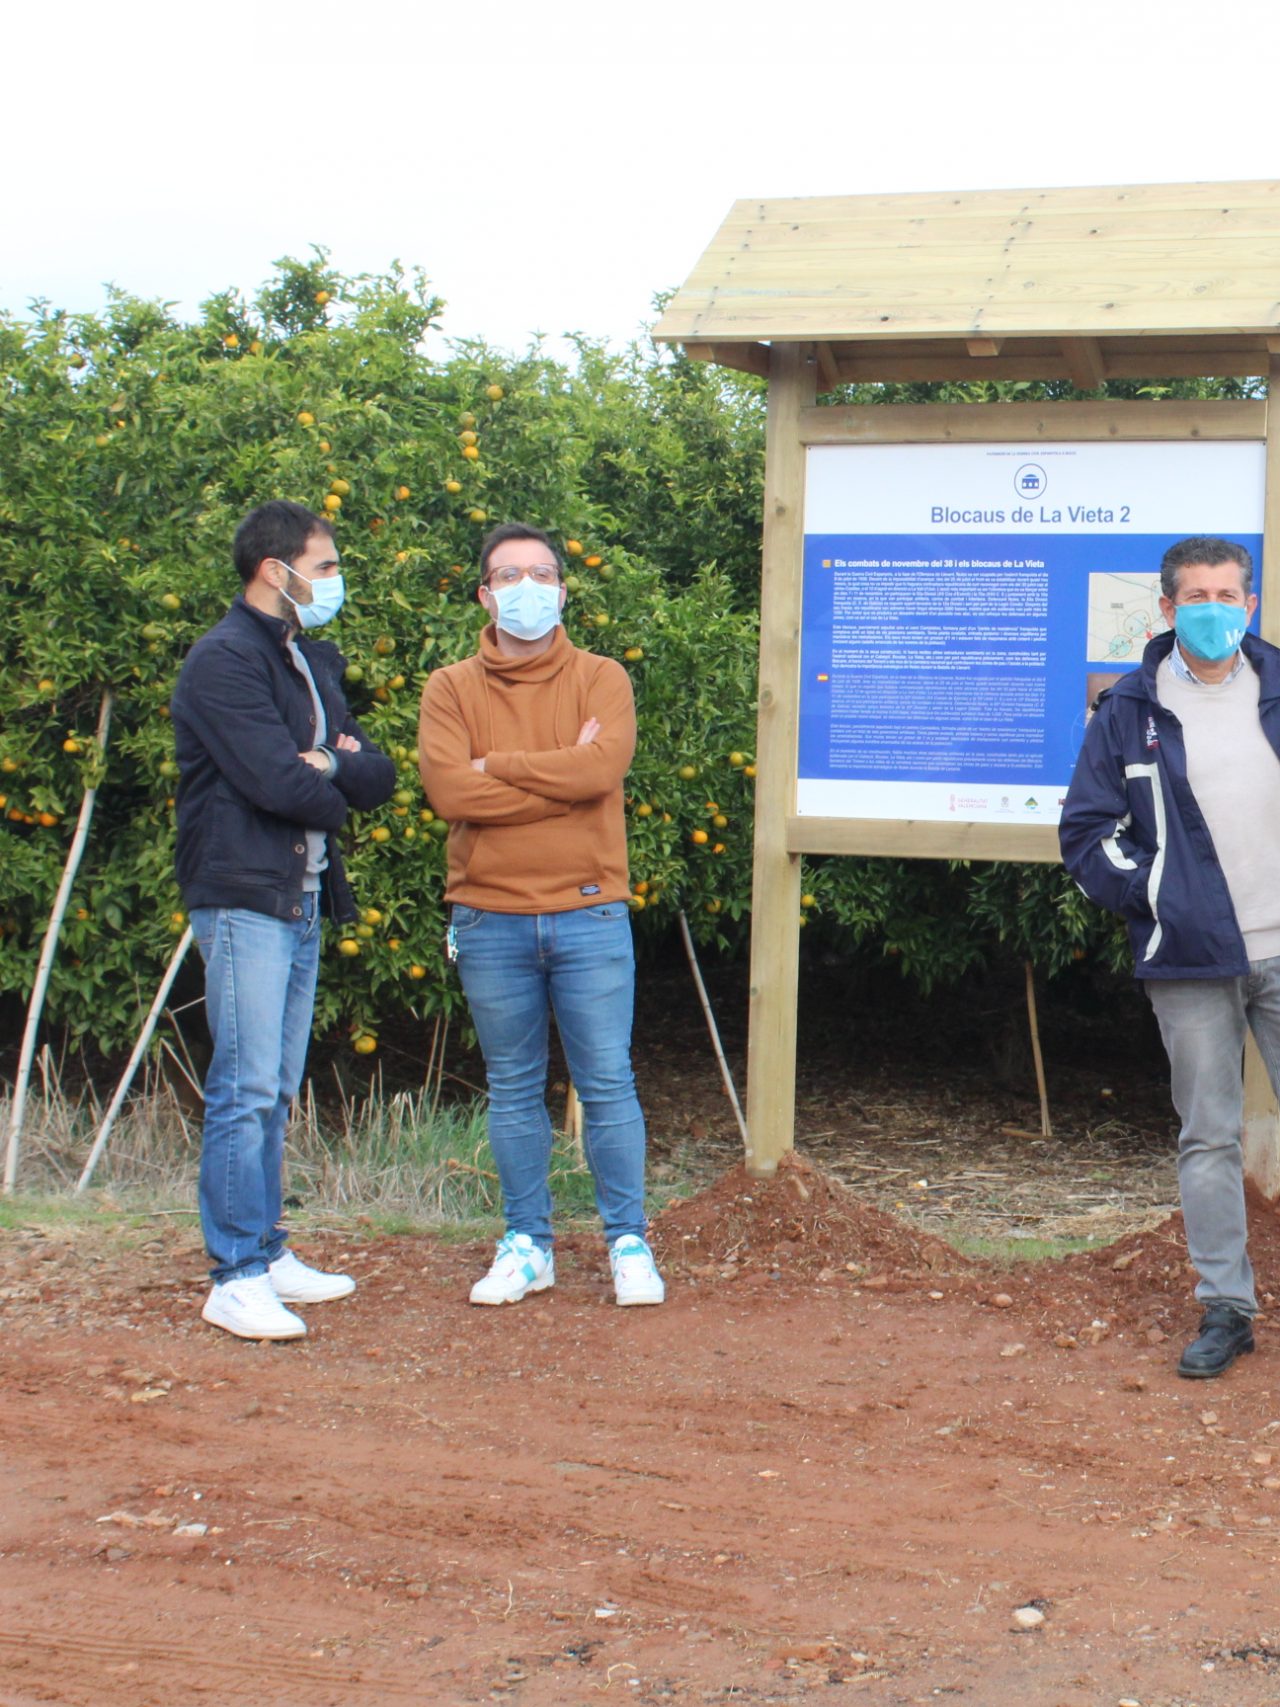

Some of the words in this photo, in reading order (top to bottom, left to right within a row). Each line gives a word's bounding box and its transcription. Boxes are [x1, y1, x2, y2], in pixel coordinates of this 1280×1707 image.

[931, 506, 1005, 523] Blocaus
[1011, 506, 1034, 523] de
[1040, 506, 1062, 523] La
[1068, 505, 1114, 523] Vieta
[1119, 505, 1131, 523] 2
[835, 559, 846, 568] Els
[848, 559, 880, 568] combats
[881, 559, 891, 568] de
[892, 559, 930, 568] novembre
[931, 559, 942, 568] del
[944, 559, 954, 568] 38
[958, 559, 970, 568] els
[972, 559, 1002, 568] blocaus
[1002, 559, 1013, 568] de
[1014, 559, 1024, 568] La
[1024, 559, 1045, 568] Vieta
